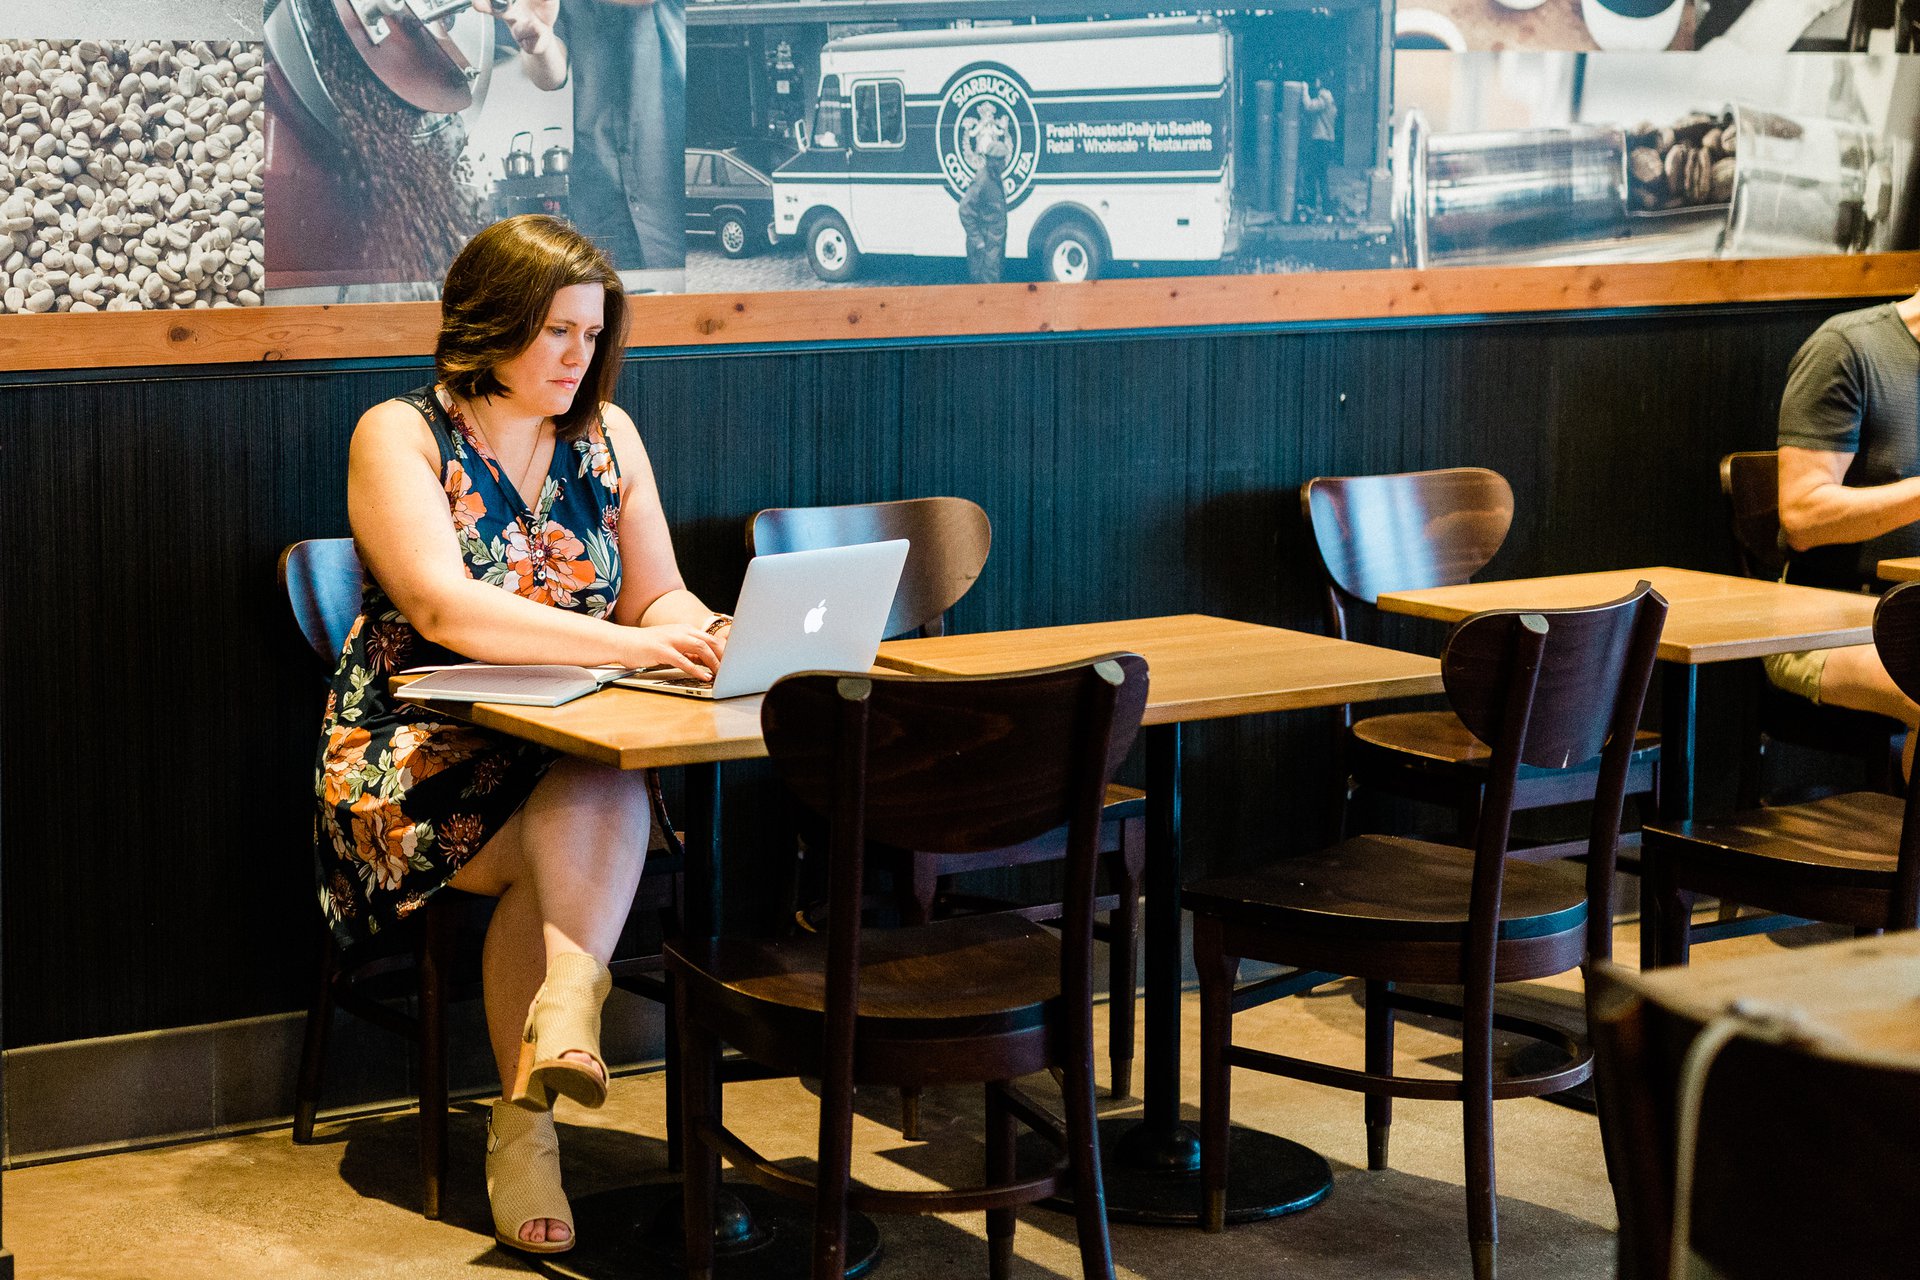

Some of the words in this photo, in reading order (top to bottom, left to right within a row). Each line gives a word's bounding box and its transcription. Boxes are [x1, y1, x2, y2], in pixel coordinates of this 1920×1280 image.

[952, 77, 1019, 108] STARBUCKS
[1046, 123, 1078, 138] Fresh
[1078, 122, 1126, 137] Roasted
[1127, 121, 1157, 138] Daily
[1156, 121, 1169, 136] in
[1169, 120, 1212, 136] Seattle
[1046, 139, 1074, 153] Retail
[1083, 138, 1138, 153] Wholesale
[1148, 136, 1212, 152] Restaurants
[945, 153, 973, 191] COFF
[1014, 152, 1033, 179] TEA
